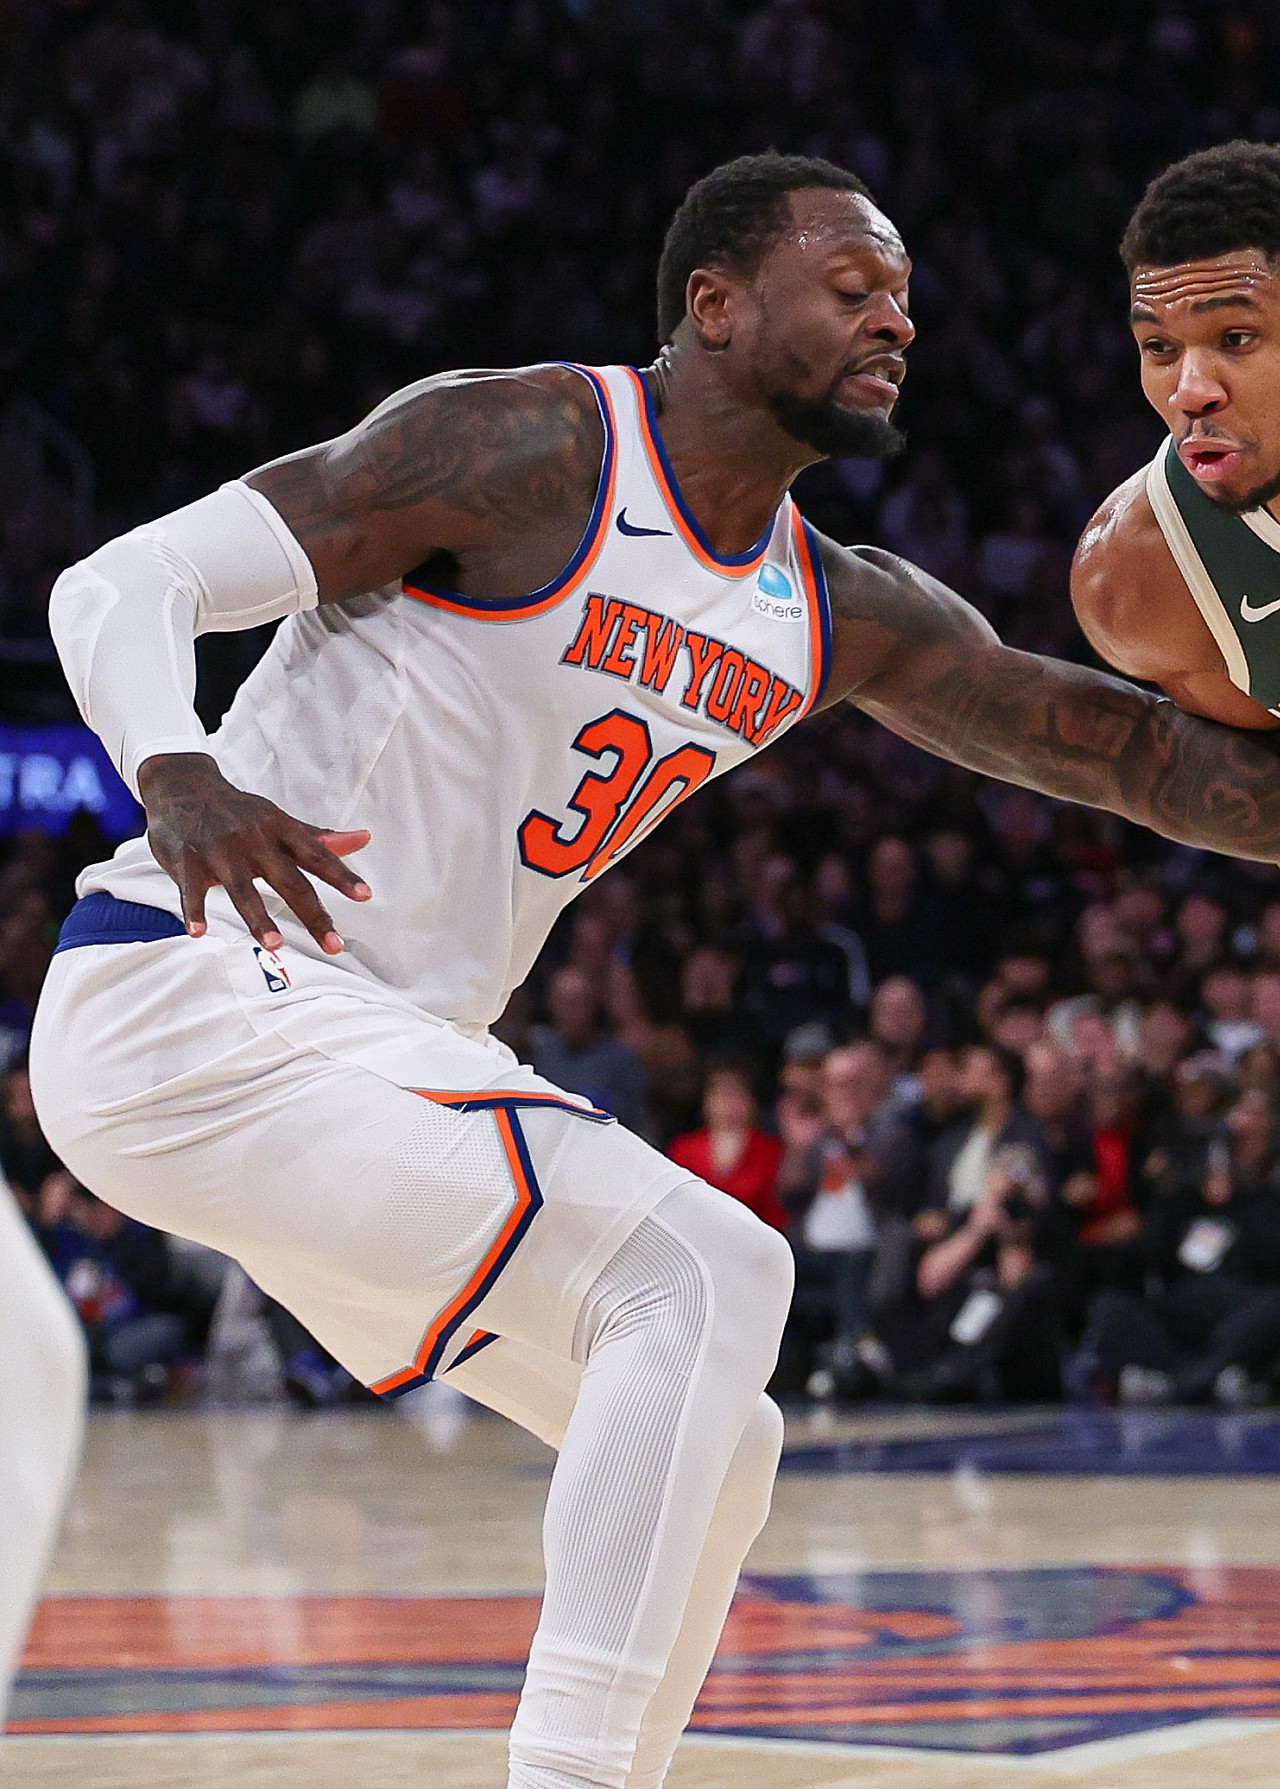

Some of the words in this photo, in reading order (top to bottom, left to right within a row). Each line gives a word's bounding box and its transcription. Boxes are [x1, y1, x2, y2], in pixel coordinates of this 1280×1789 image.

[558, 591, 685, 695] NEW
[680, 630, 807, 747] YORK
[754, 595, 803, 618] sphere
[517, 708, 717, 882] 30
